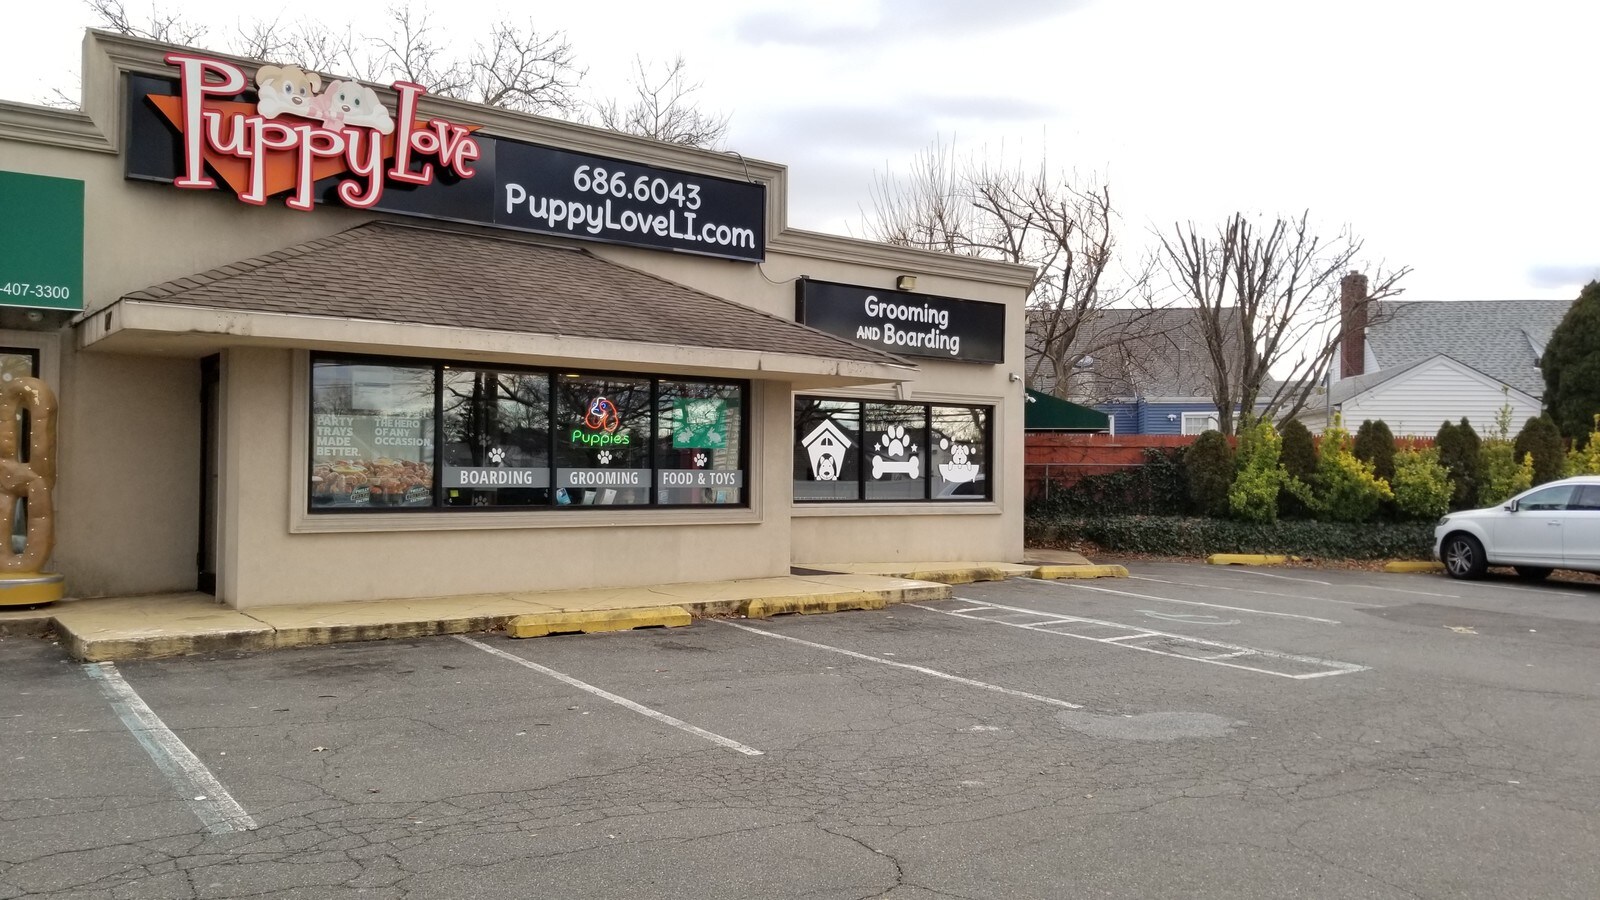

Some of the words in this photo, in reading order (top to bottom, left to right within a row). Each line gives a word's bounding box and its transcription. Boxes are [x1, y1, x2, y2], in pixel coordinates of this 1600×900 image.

[165, 53, 384, 211] Puppy
[388, 81, 480, 185] Love
[574, 165, 701, 210] 686.6043
[505, 184, 755, 249] PuppyLoveLI.com
[865, 296, 949, 329] Grooming
[857, 325, 880, 341] AND
[883, 323, 960, 355] Boarding
[316, 417, 354, 427] PARTY
[374, 418, 393, 427] THE
[394, 419, 420, 428] HERO
[316, 427, 354, 436] TRAYS
[374, 428, 388, 436] OF
[389, 428, 411, 437] ANY
[572, 429, 630, 447] Puppies
[316, 437, 351, 447] MADE
[374, 437, 433, 447] OCCASSION.
[316, 447, 361, 457] BETTER.
[460, 470, 533, 485] BOARDING
[569, 471, 639, 485] GROOMING
[663, 472, 693, 485] FOOD
[697, 472, 706, 485] &
[709, 472, 735, 485] TOYS
